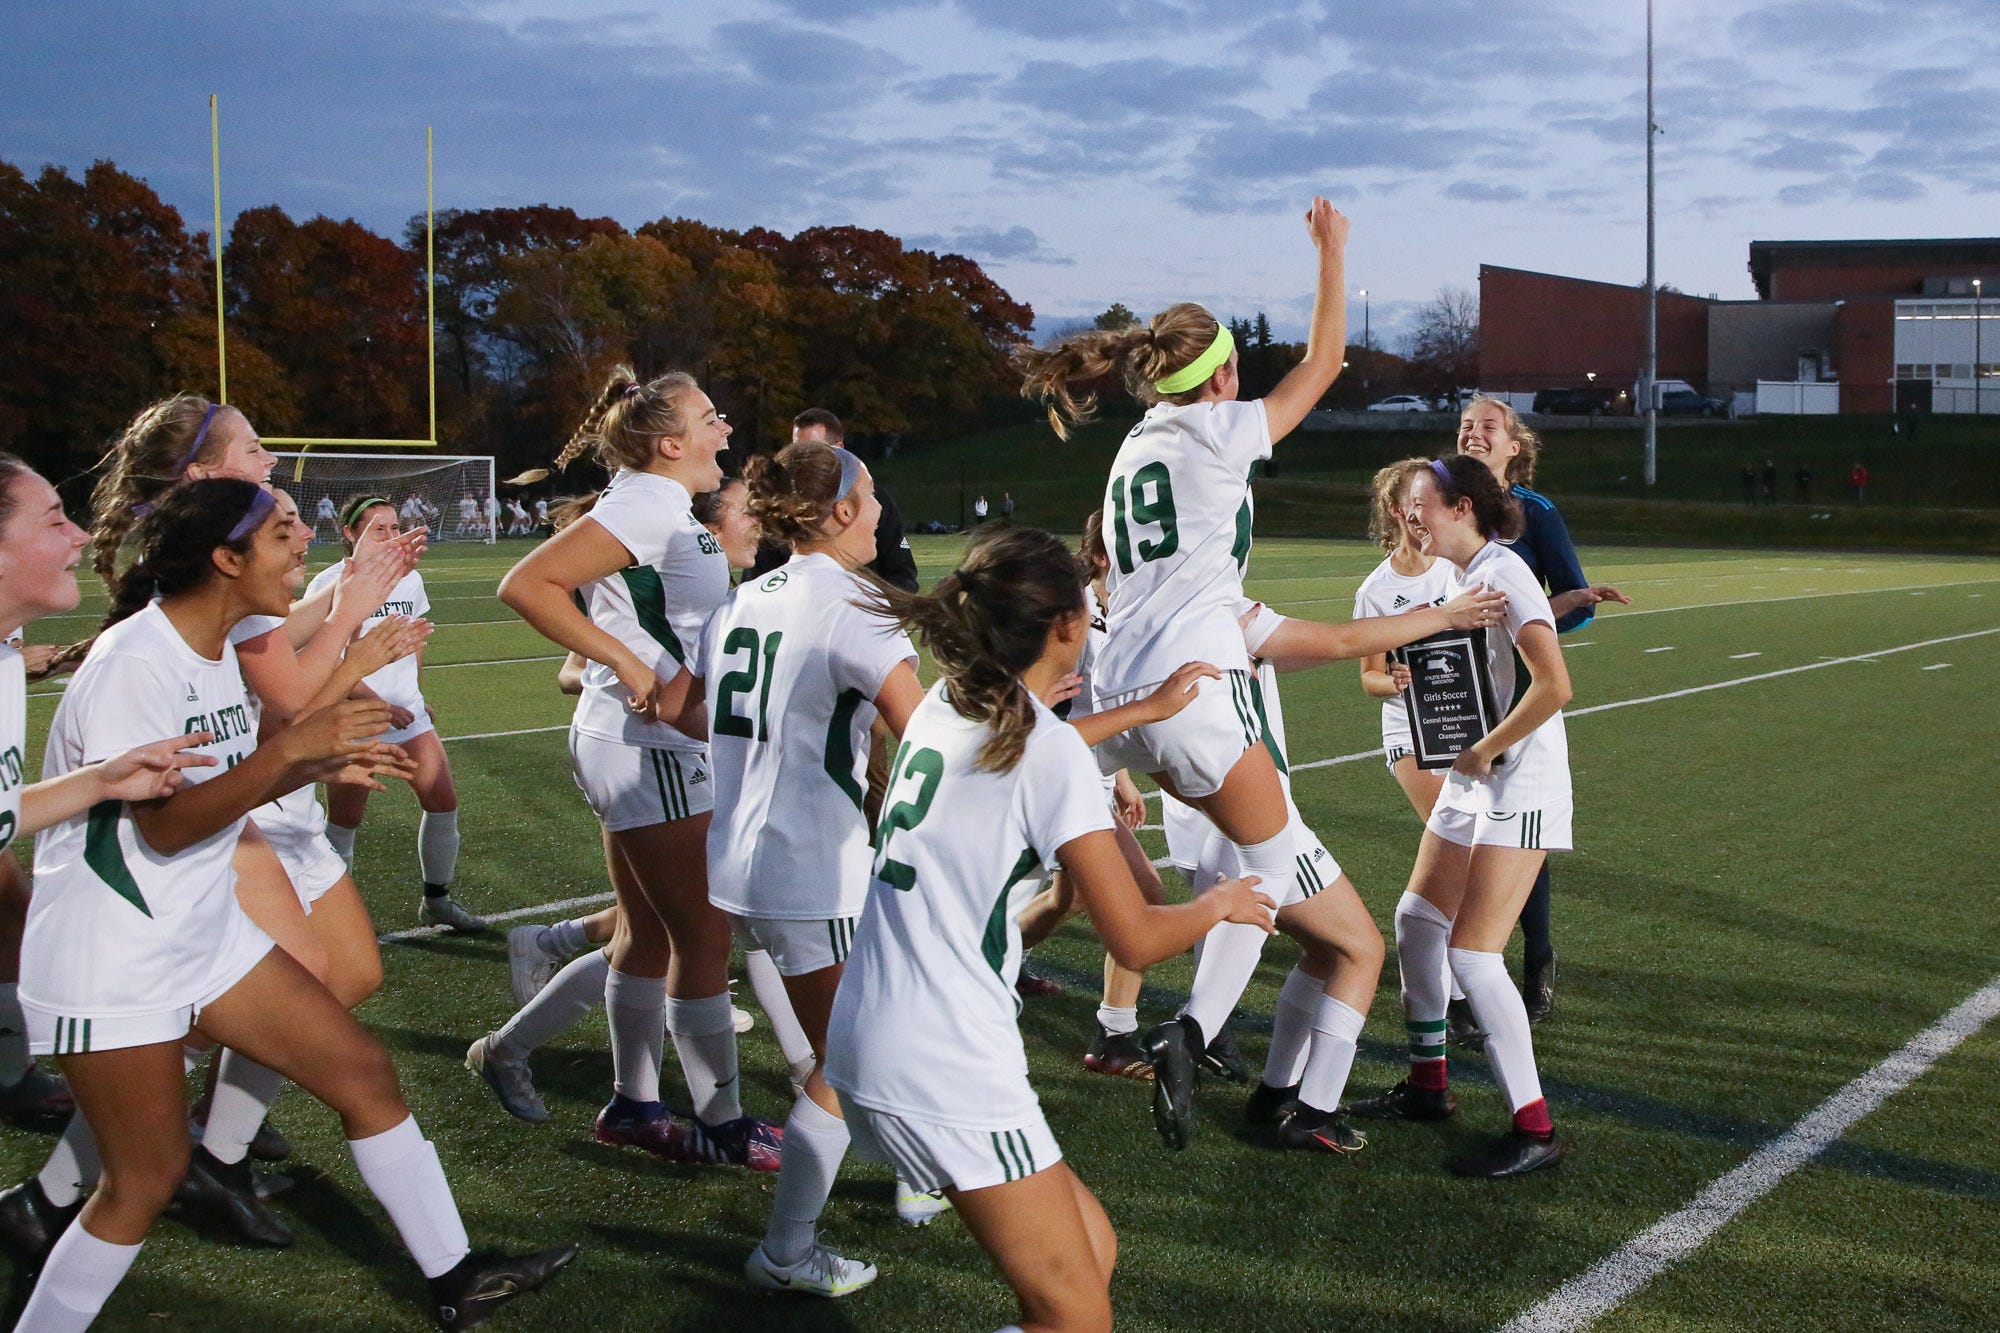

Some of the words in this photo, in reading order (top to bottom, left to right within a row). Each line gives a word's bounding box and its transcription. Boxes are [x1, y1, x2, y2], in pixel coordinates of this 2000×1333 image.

[1112, 461, 1179, 575] 19
[370, 601, 414, 618] AFTON
[713, 627, 783, 743] 21
[1423, 693, 1441, 702] Girls
[1442, 691, 1468, 700] Soccer
[184, 704, 251, 749] GRAFTO
[1442, 714, 1478, 722] Massachusetts
[1438, 732, 1467, 740] Champions
